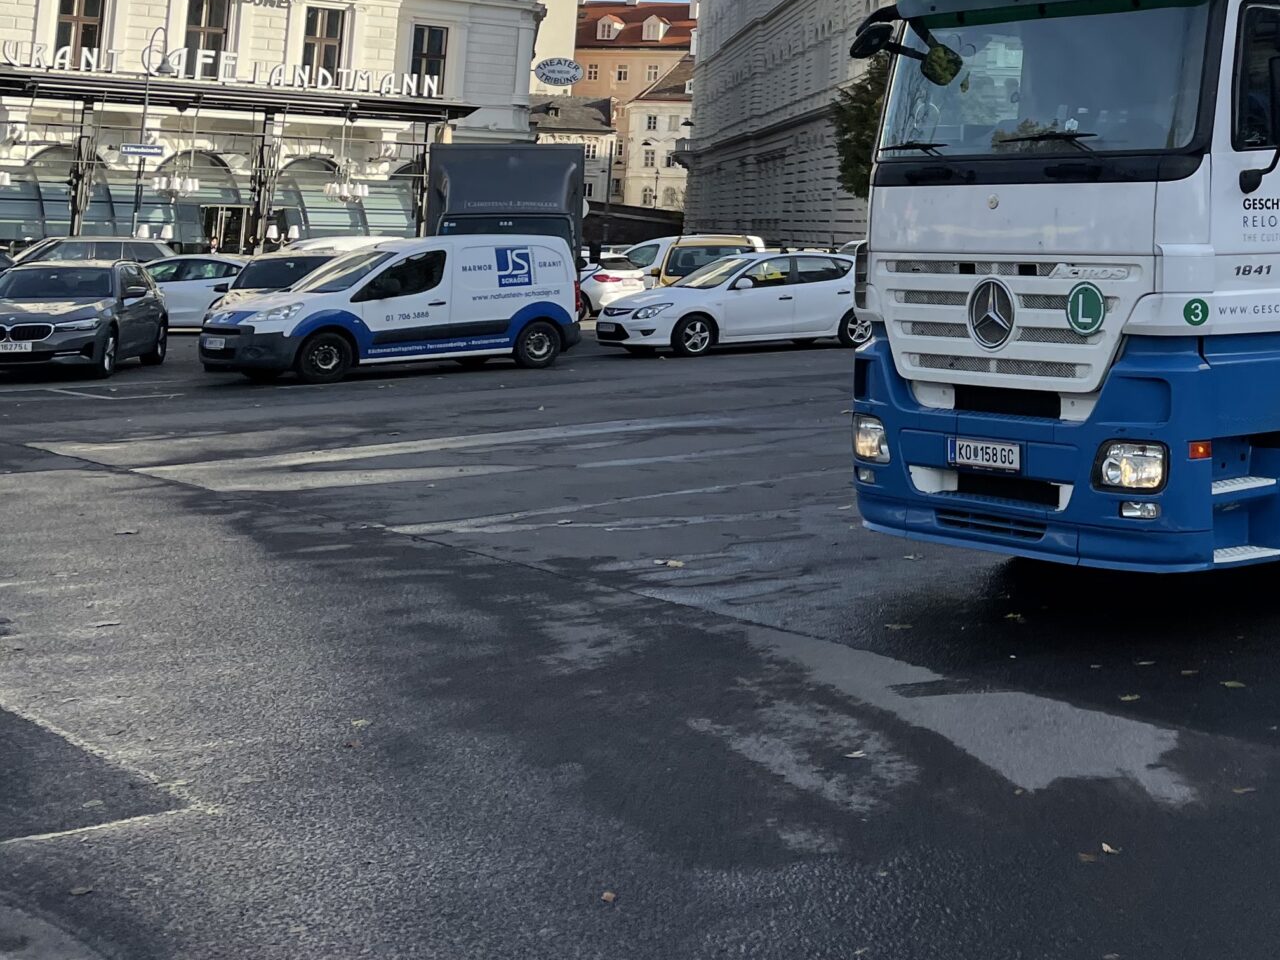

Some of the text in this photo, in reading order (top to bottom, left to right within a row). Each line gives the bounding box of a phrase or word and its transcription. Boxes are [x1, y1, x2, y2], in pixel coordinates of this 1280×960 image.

[537, 59, 580, 72] THEATER
[253, 61, 439, 98] LANDTMANN
[1243, 233, 1258, 242] THE
[461, 264, 493, 272] MARMOR
[538, 260, 562, 268] GRANIT
[1234, 264, 1272, 276] 1841
[1077, 293, 1092, 324] L
[1190, 302, 1203, 322] 3
[385, 314, 394, 322] 01
[958, 443, 972, 460] KO
[979, 445, 998, 464] 158
[1000, 447, 1014, 465] GC
